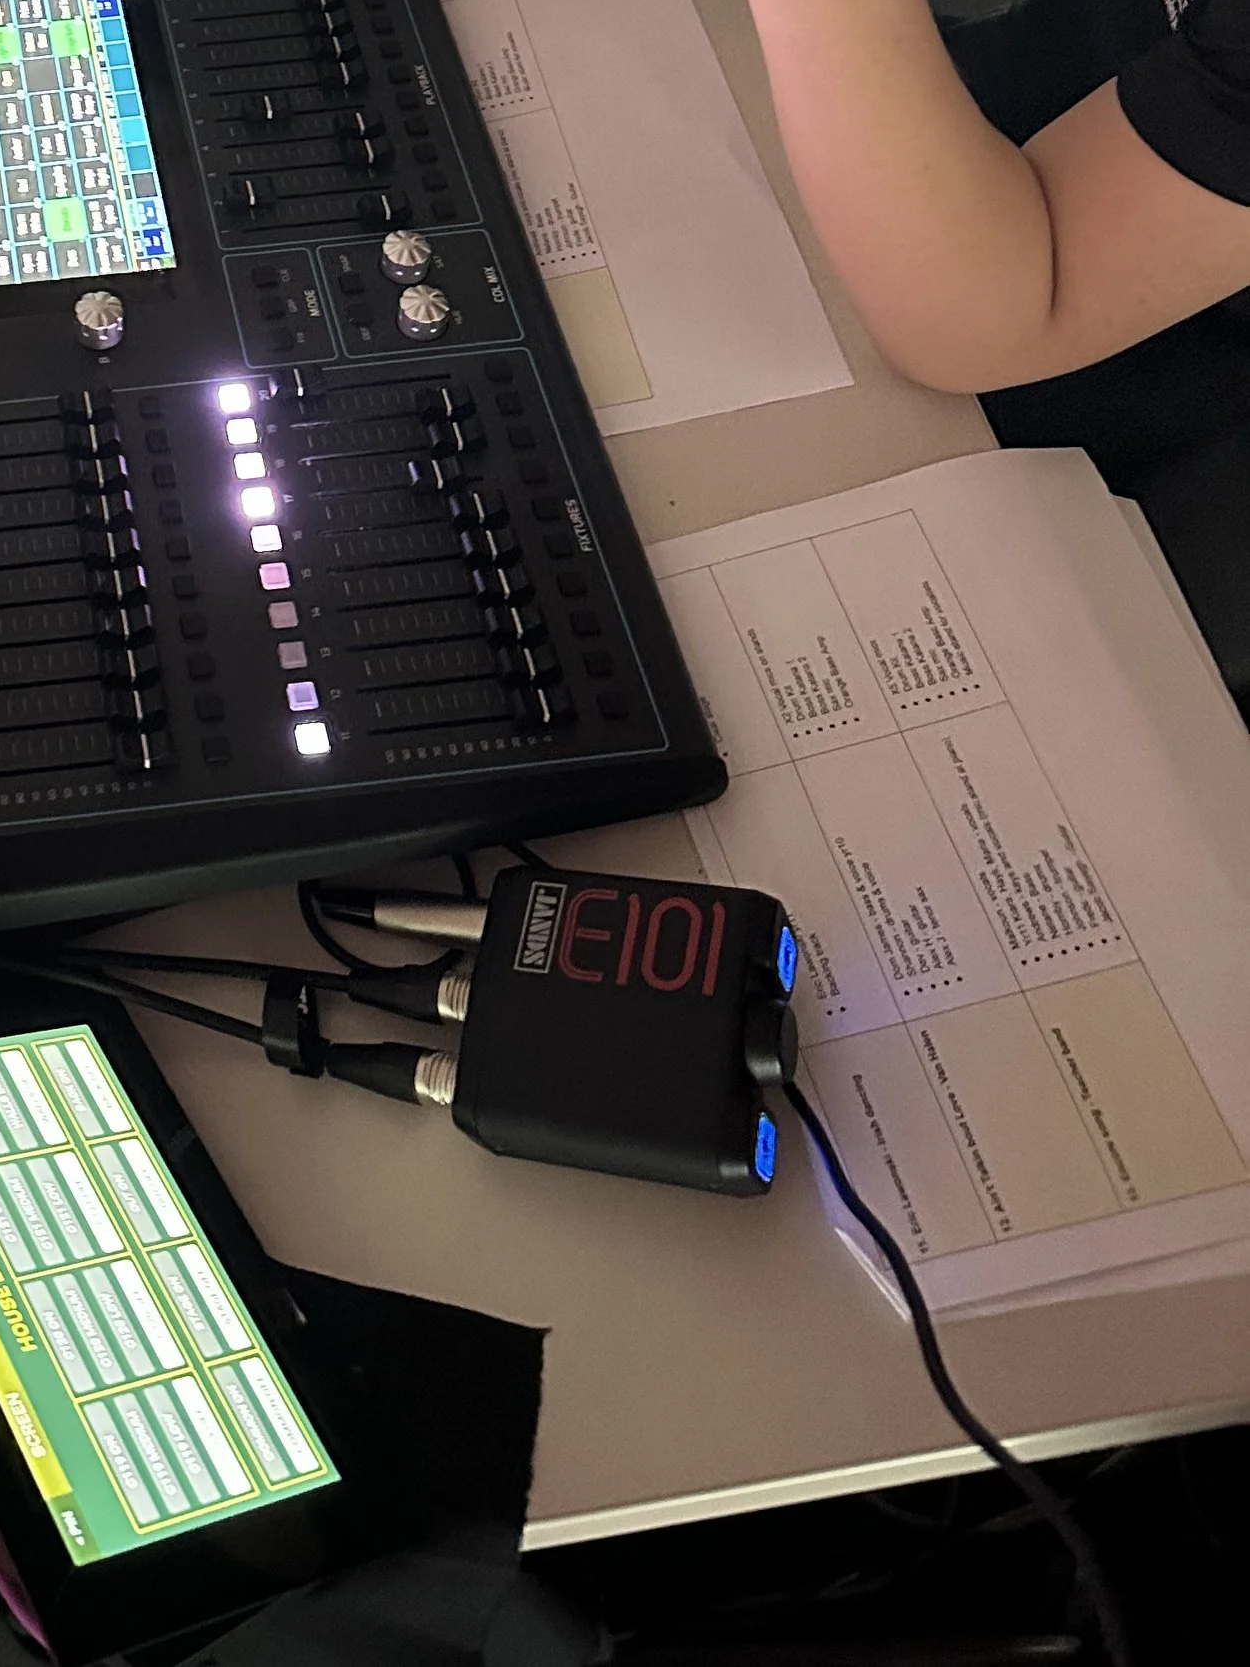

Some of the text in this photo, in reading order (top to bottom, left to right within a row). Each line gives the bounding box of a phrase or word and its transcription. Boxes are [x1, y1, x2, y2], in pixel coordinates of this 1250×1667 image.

[413, 64, 437, 106] PLAYBACK
[483, 265, 506, 303] COL MIX
[303, 289, 322, 318] MODE
[564, 498, 593, 553] FIXTURES
[745, 627, 763, 655] stands
[814, 634, 855, 708] Orange Bass Amp
[920, 664, 937, 685] Boss
[934, 665, 949, 682] Sax
[939, 647, 963, 679] Orange
[894, 668, 912, 692] Drum
[908, 667, 925, 689] Boss
[771, 687, 787, 710] Vocal
[789, 697, 806, 721] Drum
[802, 696, 818, 718] Boss
[813, 693, 830, 714] Boss
[828, 694, 842, 711] Sax
[959, 774, 978, 800] stand
[834, 835, 852, 858] yr10
[981, 821, 1003, 850] vocals
[844, 858, 862, 883] voice
[859, 861, 878, 887] voice
[996, 851, 1012, 870] and
[1005, 870, 1025, 893] keys
[1038, 847, 1087, 932] Johnson trumpet
[859, 893, 877, 917] bass
[875, 896, 896, 927] drums
[523, 887, 558, 967] JANDS
[914, 885, 957, 967] Alex J tenor sax
[1019, 899, 1048, 943] Andrews
[558, 887, 726, 997] E101
[872, 923, 894, 955] James
[907, 902, 944, 970] Alex H guitar
[807, 932, 842, 996] Backing track
[886, 956, 905, 980] Dom
[891, 933, 917, 977] Shannon
[918, 1029, 940, 1061] Halen
[1050, 1026, 1071, 1055] band
[54, 1067, 72, 1084] ON
[932, 1062, 949, 1083] Van
[1064, 1056, 1093, 1100] Teacher
[849, 1072, 878, 1118] dancing
[944, 1091, 965, 1120] Love
[868, 1119, 887, 1146] Irish
[957, 1120, 977, 1147] bout
[1089, 1108, 1111, 1138] song
[968, 1148, 992, 1183] Talkin
[8, 1176, 40, 1221] MEDIUM
[41, 1180, 64, 1206] LOW
[983, 1182, 1005, 1213] Ain't
[904, 1209, 923, 1235] Eric
[64, 1288, 98, 1337] MEDIUM
[98, 1290, 122, 1319] LOW
[166, 1274, 206, 1331] STAGE ON
[41, 1309, 61, 1330] ON
[3, 1390, 48, 1459] SCREEN
[125, 1409, 162, 1462] MEDIUM
[160, 1410, 186, 1442] LOW
[101, 1432, 123, 1456] ON
